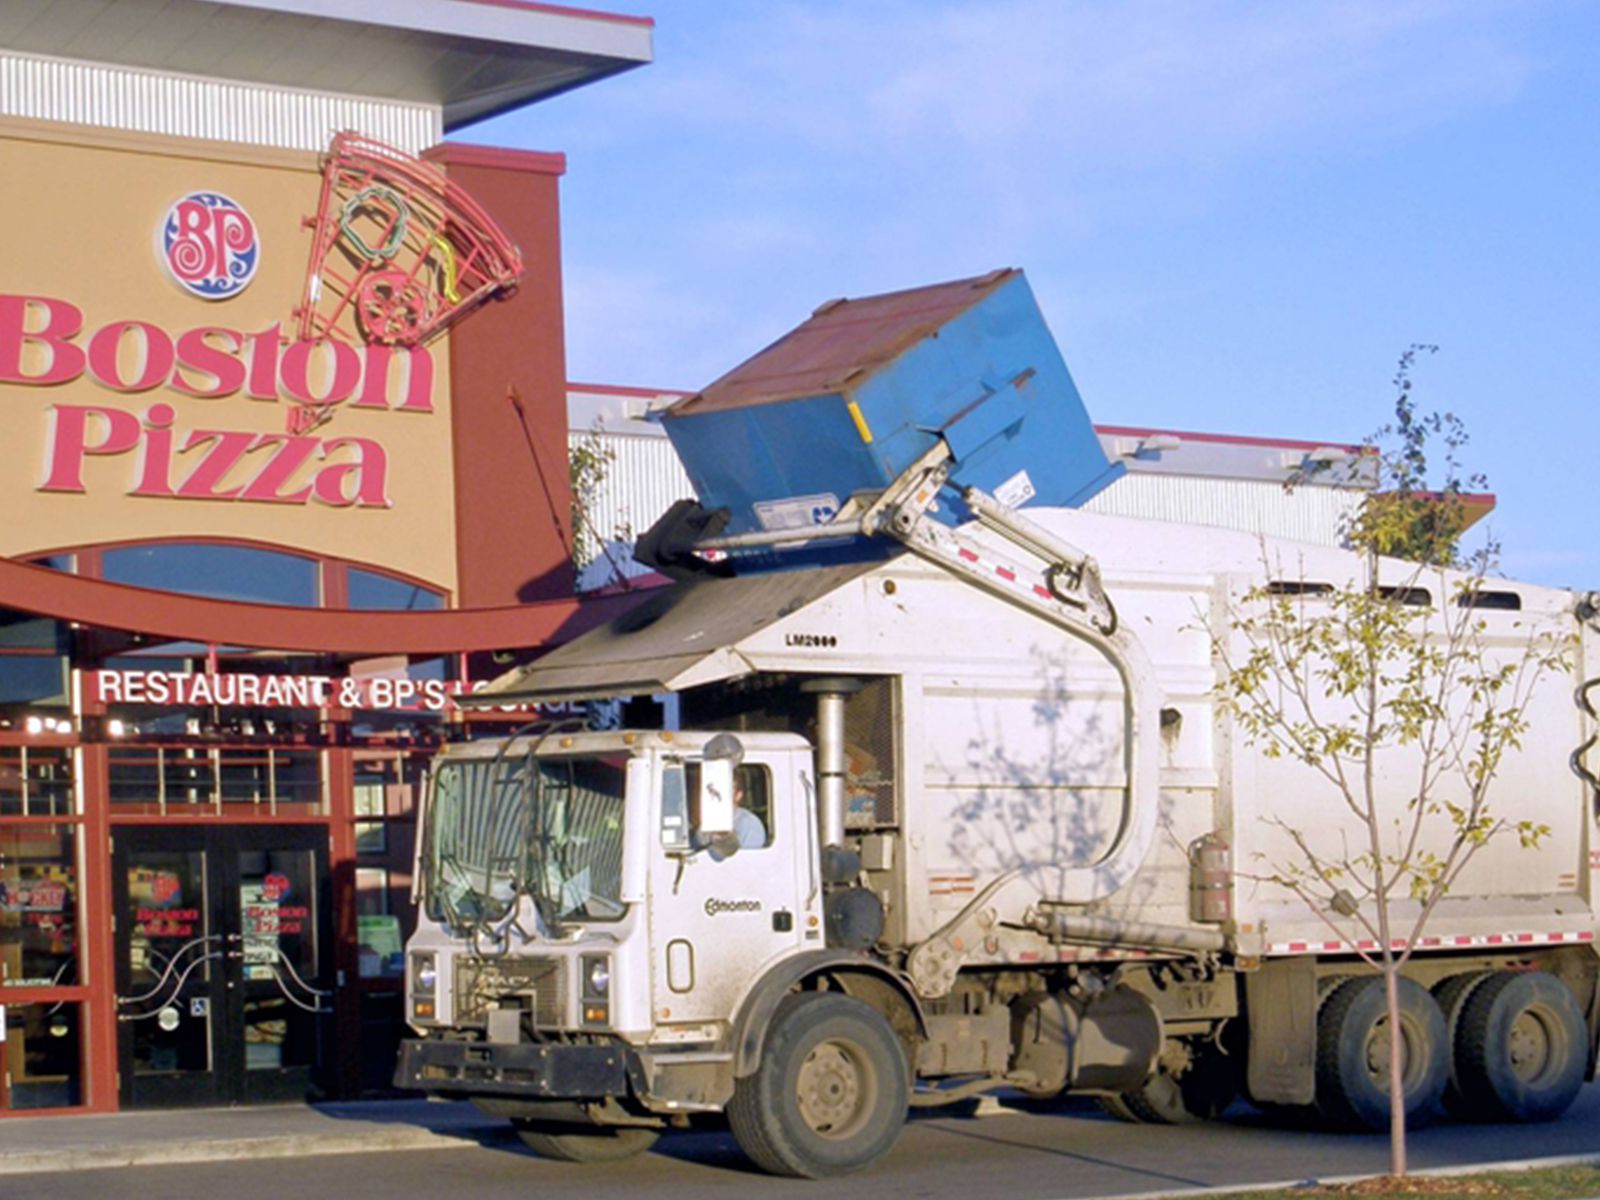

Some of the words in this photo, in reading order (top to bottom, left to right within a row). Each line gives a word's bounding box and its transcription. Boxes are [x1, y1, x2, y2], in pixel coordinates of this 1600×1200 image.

[166, 199, 255, 281] BP
[0, 293, 435, 413] Boston
[36, 403, 393, 509] Pizza
[97, 670, 331, 707] RESTAURANT
[338, 678, 362, 708] &
[372, 678, 446, 711] BP'S
[704, 897, 762, 917] Edmonton
